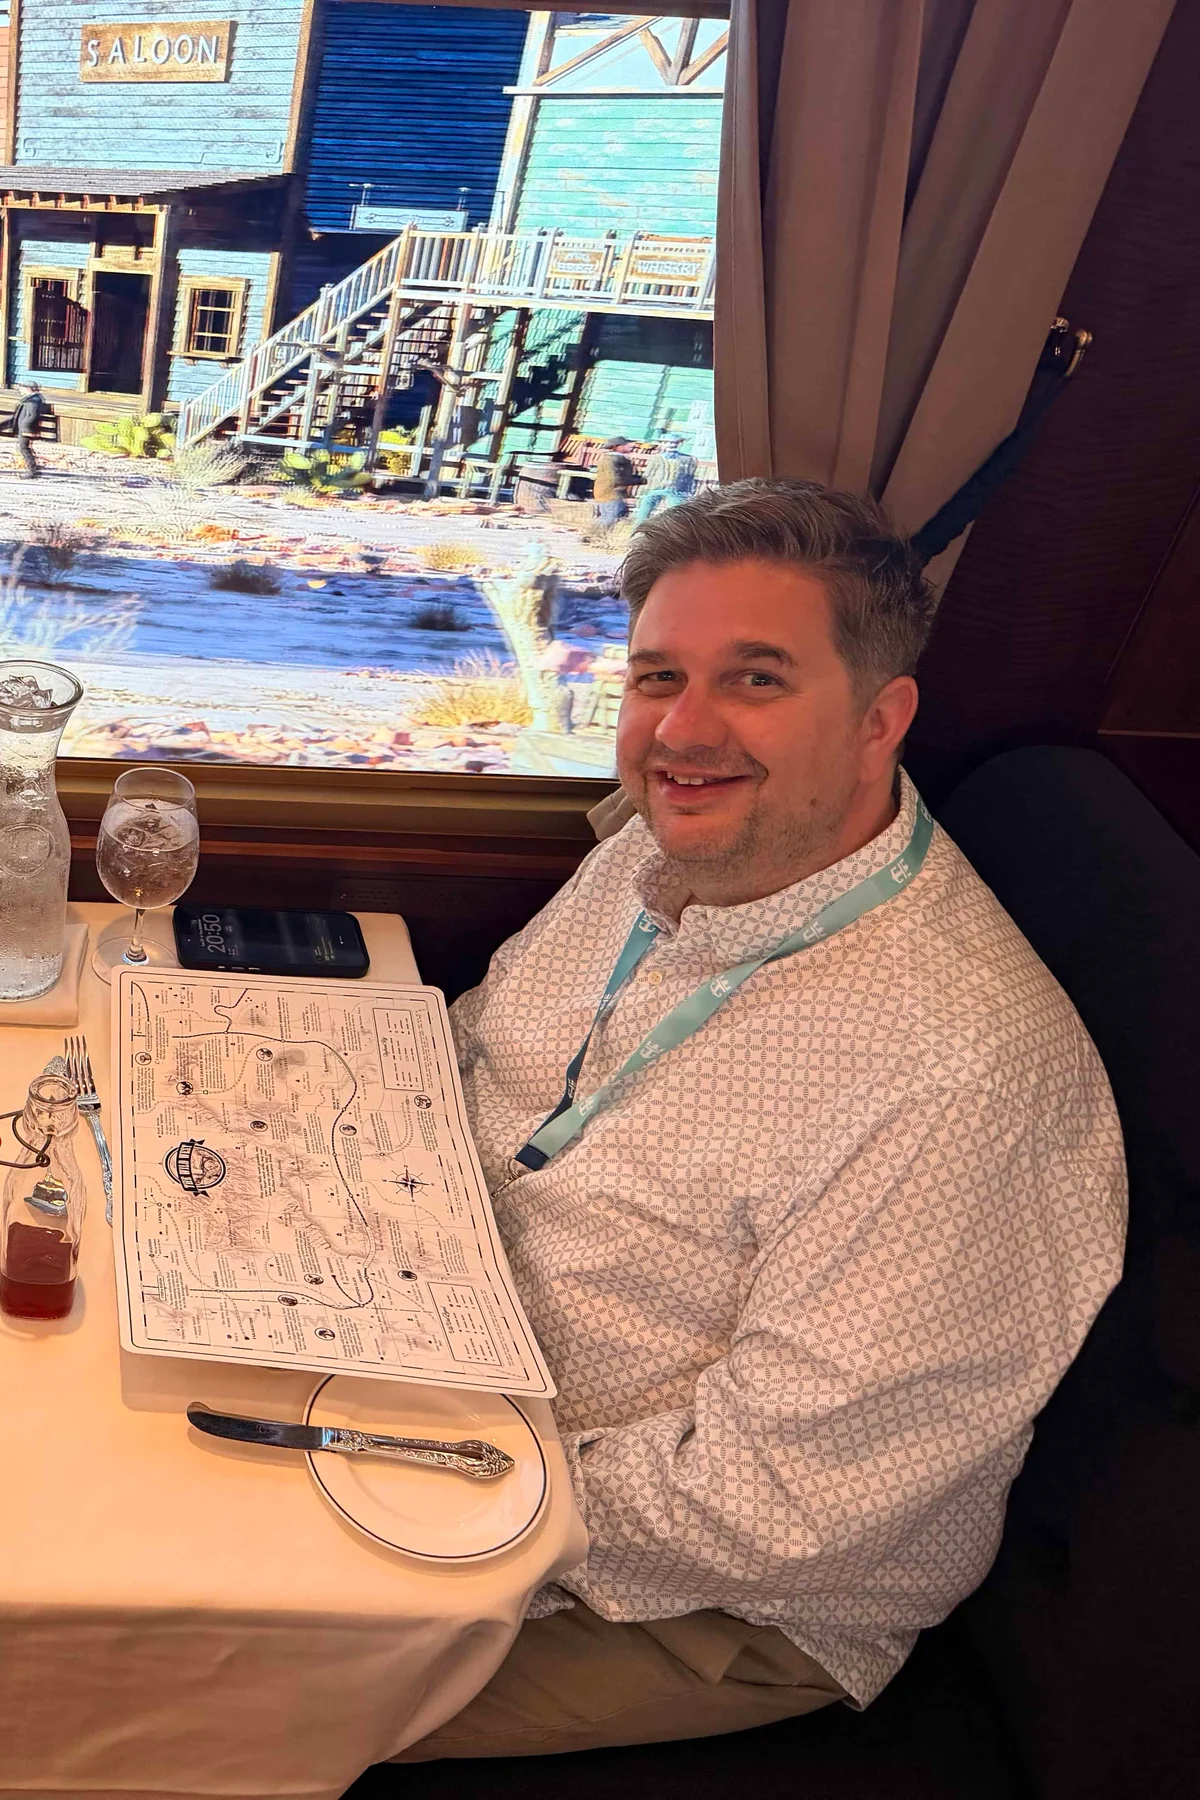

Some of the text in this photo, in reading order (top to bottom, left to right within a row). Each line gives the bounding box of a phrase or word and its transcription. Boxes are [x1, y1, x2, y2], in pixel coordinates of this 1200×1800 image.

[86, 34, 219, 68] SALOON
[202, 914, 226, 954] 20:50
[178, 1144, 197, 1188] THE WILD WEST
